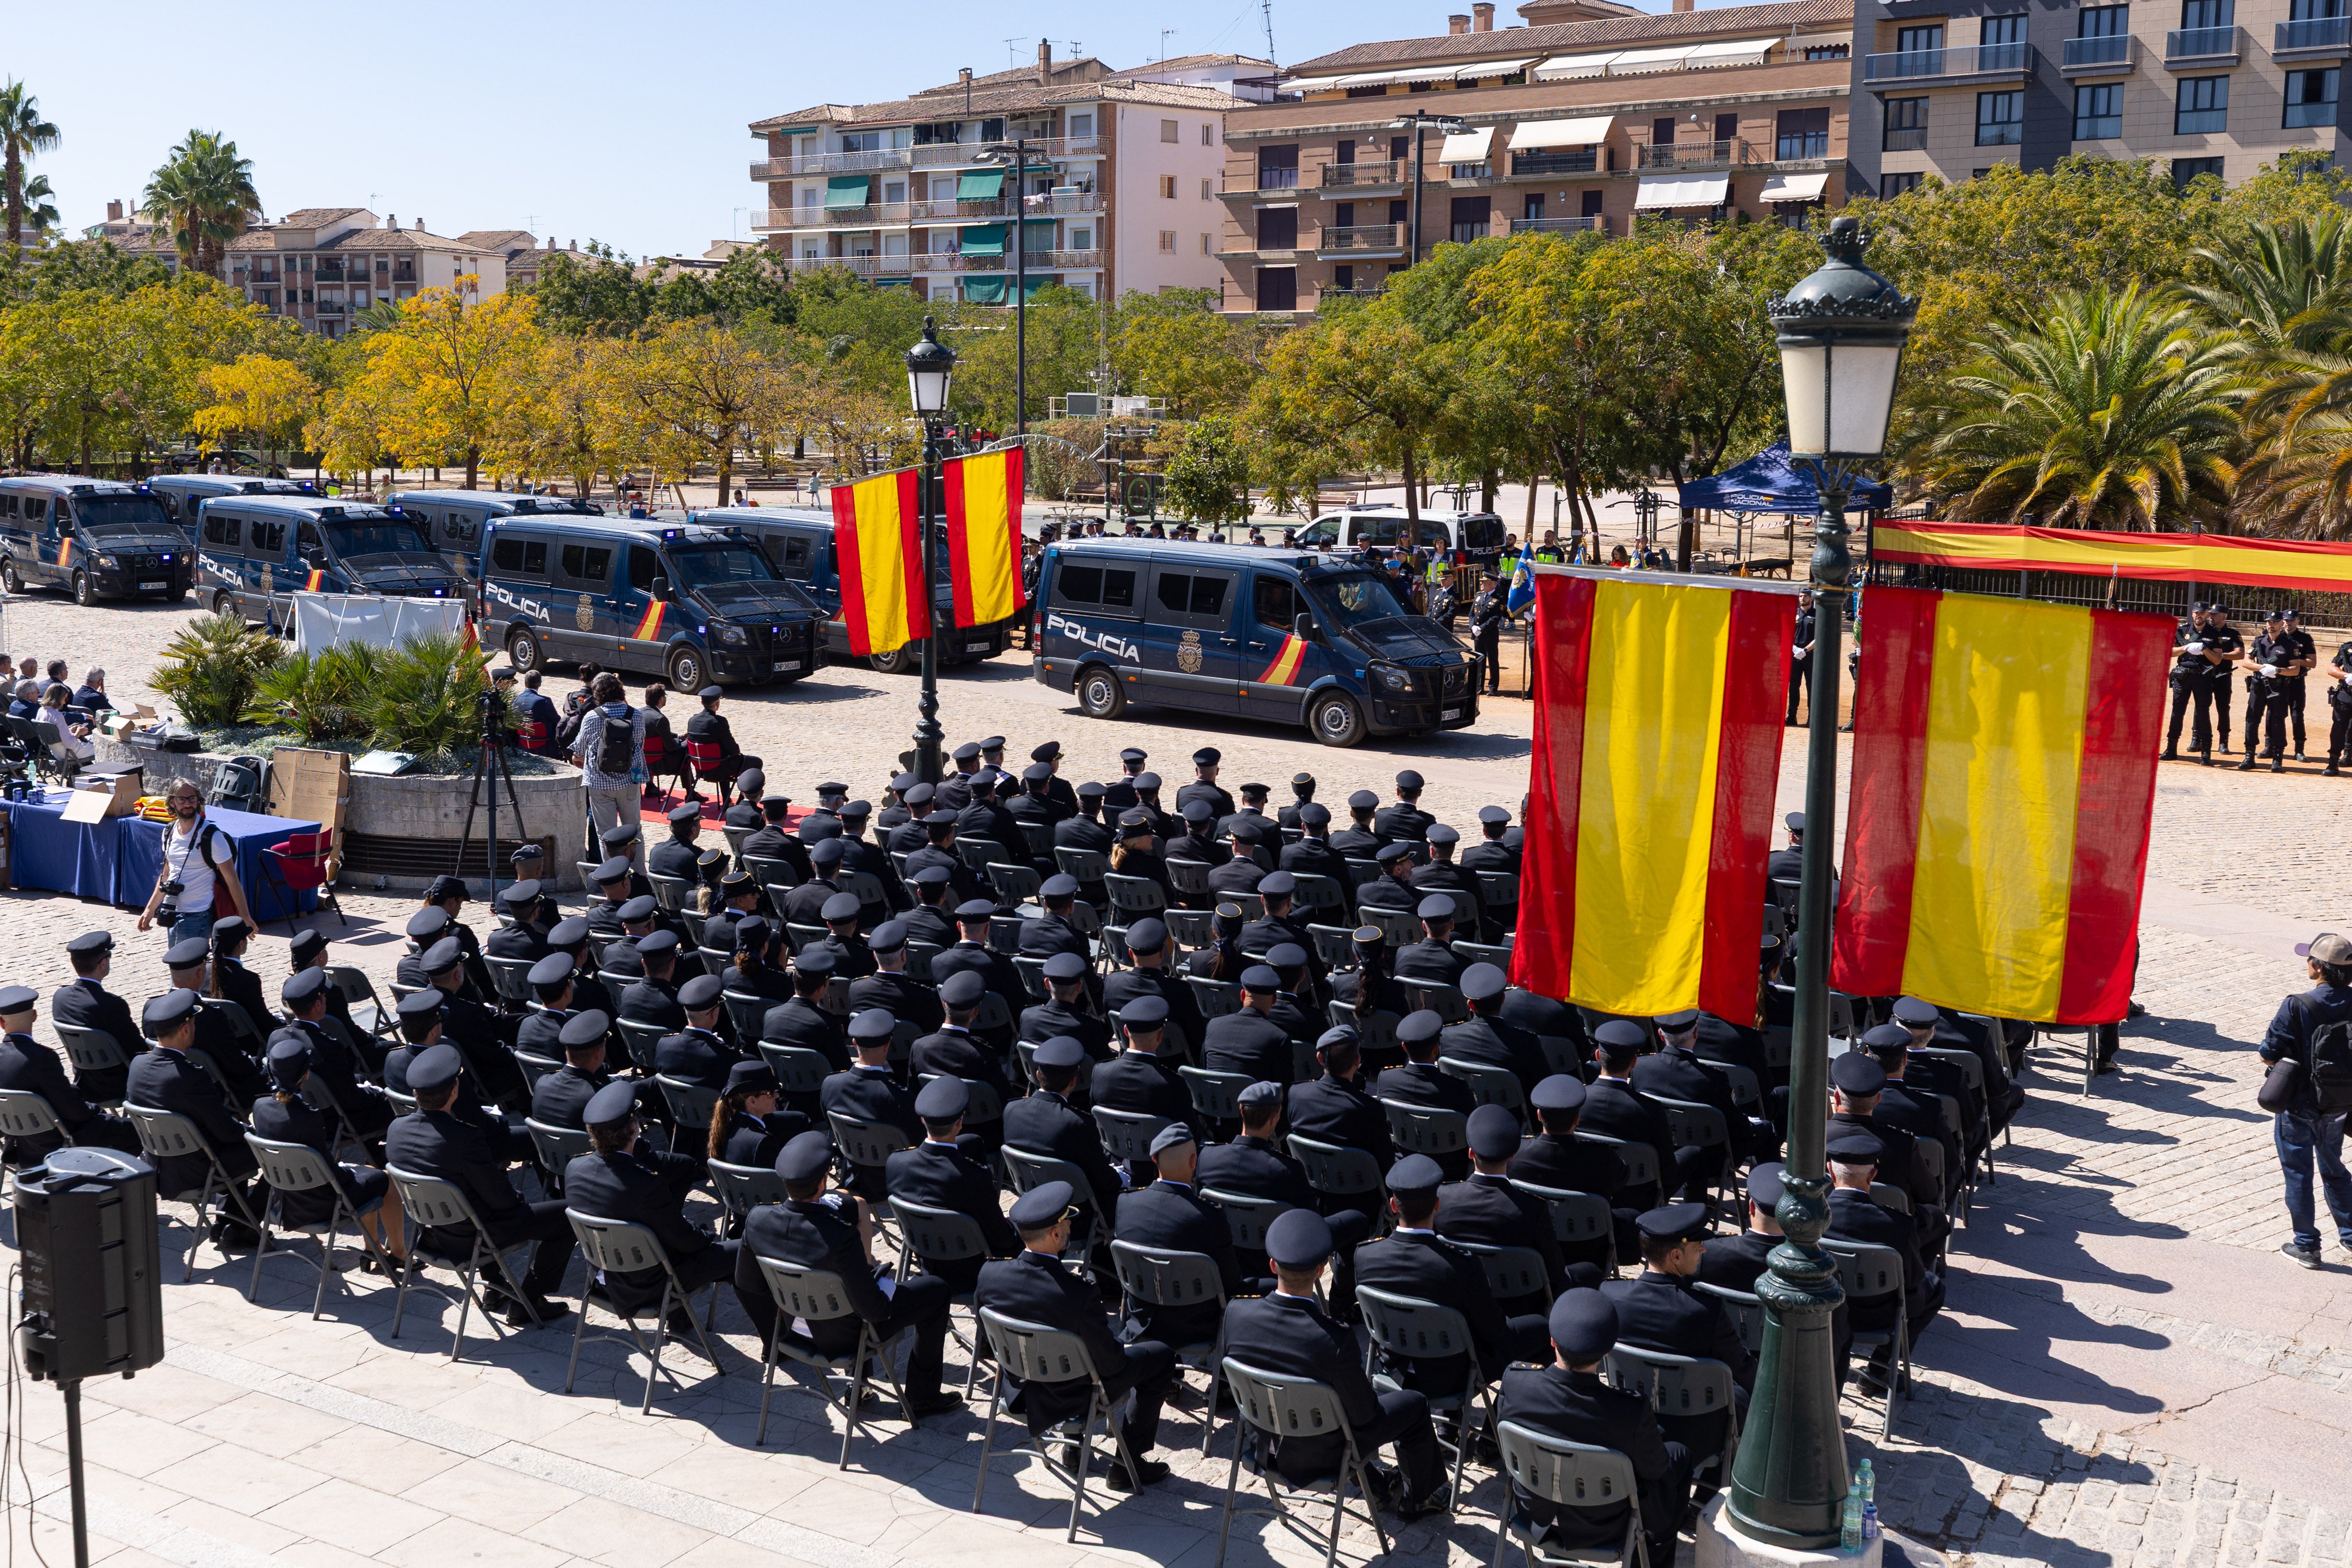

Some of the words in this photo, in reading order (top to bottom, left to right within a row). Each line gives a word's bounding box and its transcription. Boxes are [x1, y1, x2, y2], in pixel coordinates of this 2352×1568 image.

[199, 553, 244, 589] POLICÍA
[486, 582, 550, 623] POLICÍA
[1047, 614, 1140, 663] POLICÍA
